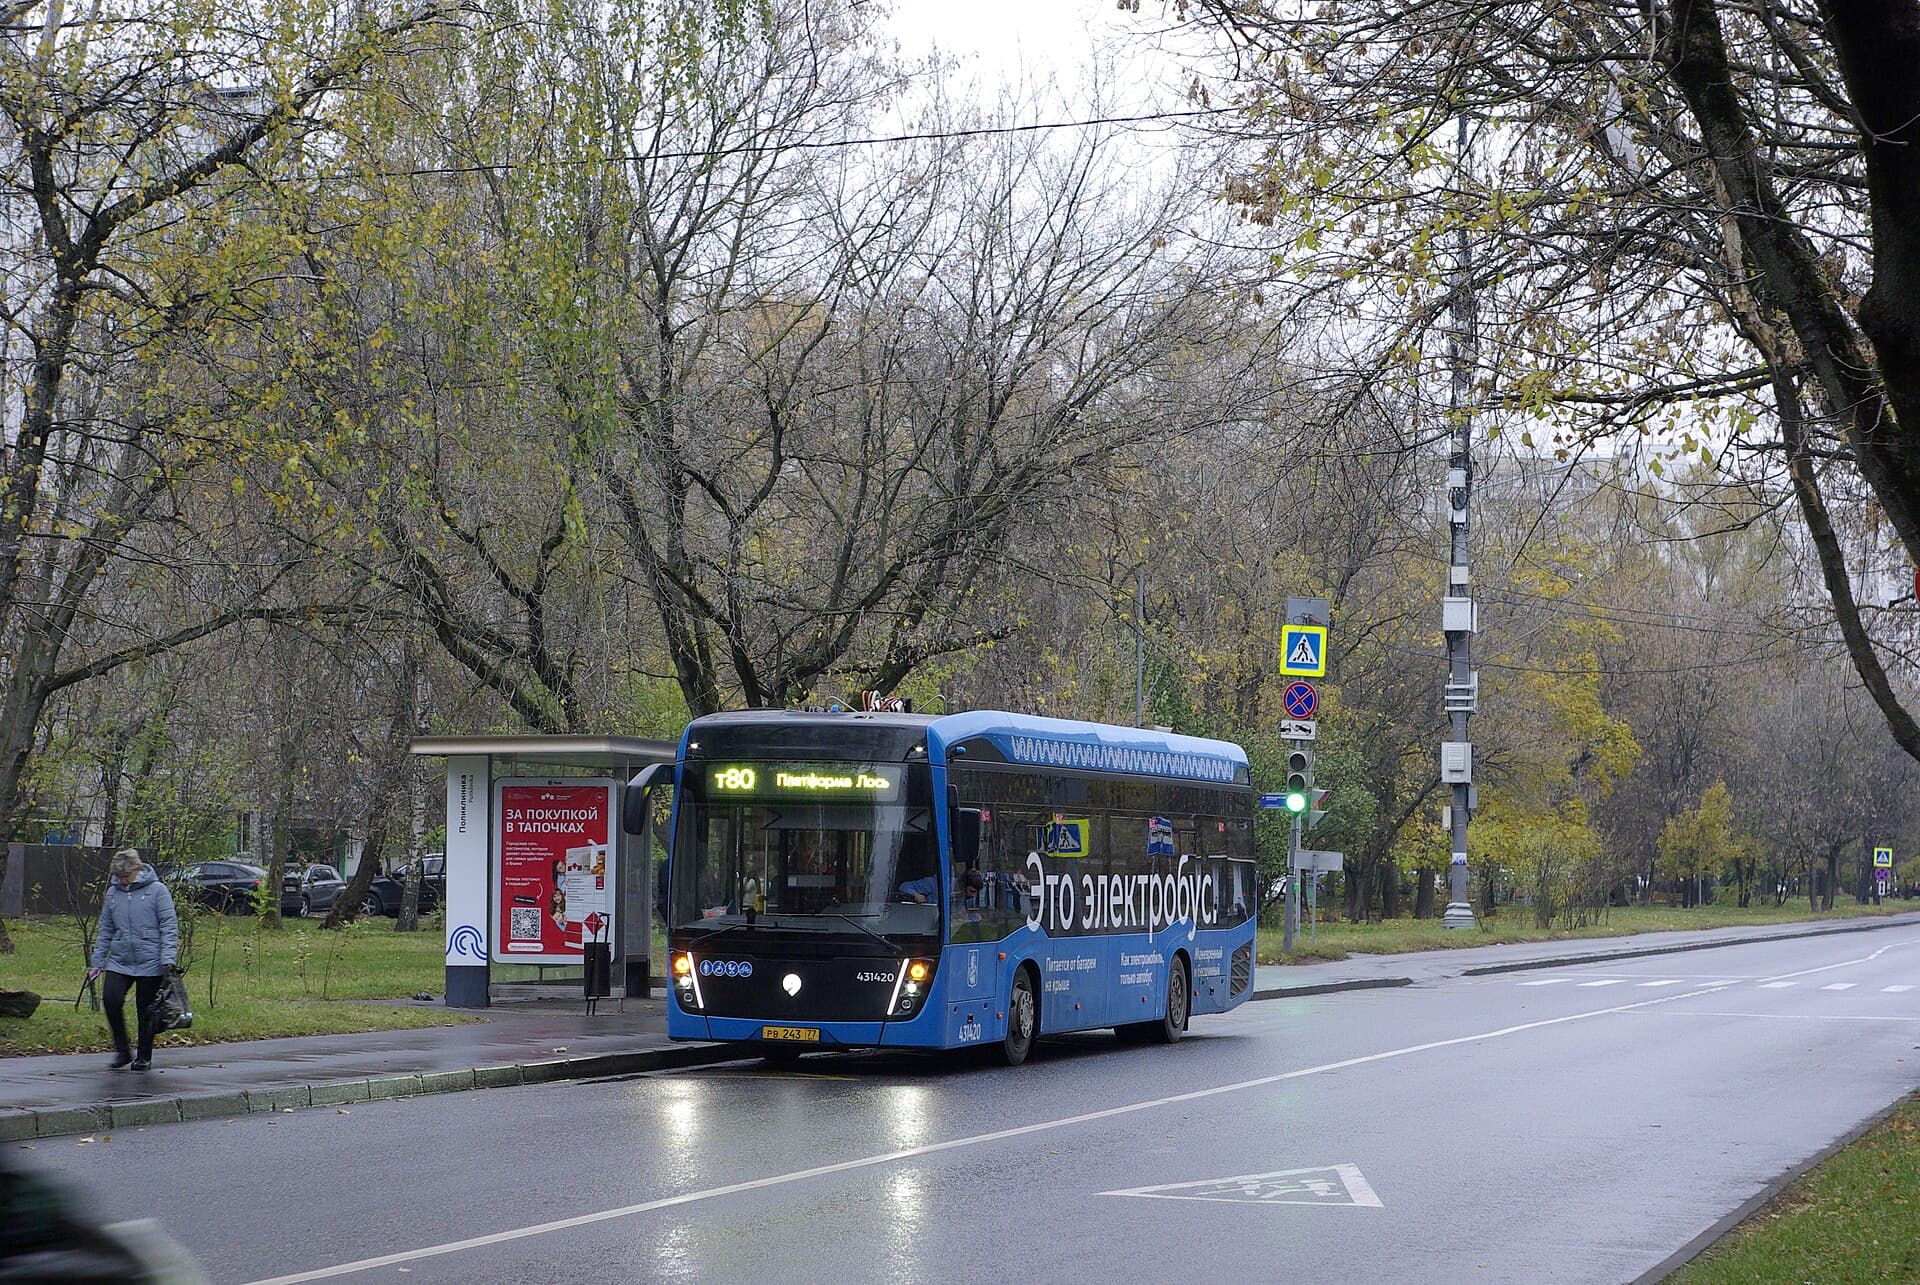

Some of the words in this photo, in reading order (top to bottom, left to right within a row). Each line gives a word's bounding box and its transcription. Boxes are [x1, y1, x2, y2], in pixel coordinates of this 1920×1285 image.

[714, 768, 755, 790] т80
[776, 772, 852, 790] Платформа
[856, 774, 889, 789] Лось
[459, 774, 467, 833] Поликлиника
[506, 808, 522, 820] ЗА
[526, 806, 598, 820] ПОКУПКОЙ
[506, 822, 514, 833] В
[518, 822, 584, 833] ТАПОЧКАХ
[1026, 852, 1075, 932] Это
[1045, 956, 1069, 972] Питается
[1069, 959, 1076, 971] от
[856, 972, 895, 983] 431420
[782, 1028, 801, 1040] 243
[806, 1029, 817, 1038] 77
[958, 1023, 981, 1042] 431420
